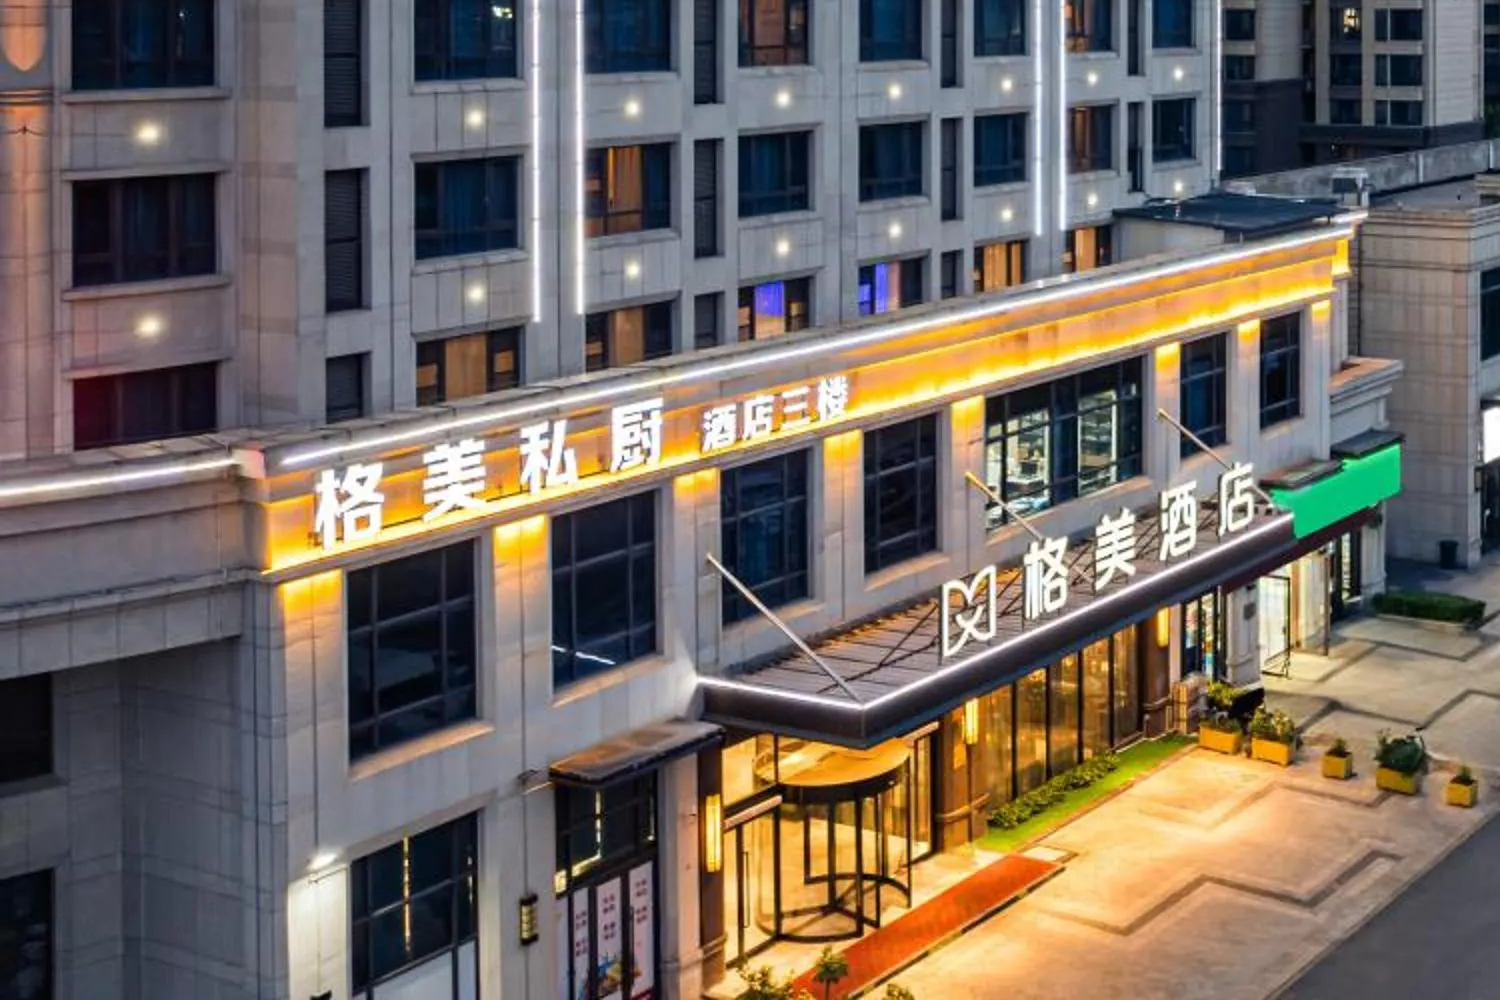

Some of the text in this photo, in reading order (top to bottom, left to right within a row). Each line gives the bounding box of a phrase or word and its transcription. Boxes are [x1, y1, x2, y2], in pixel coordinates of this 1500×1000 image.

[314, 397, 665, 548] 格美私厨
[702, 375, 850, 452] 酒店三楼
[1023, 462, 1256, 620] 格美酒店
